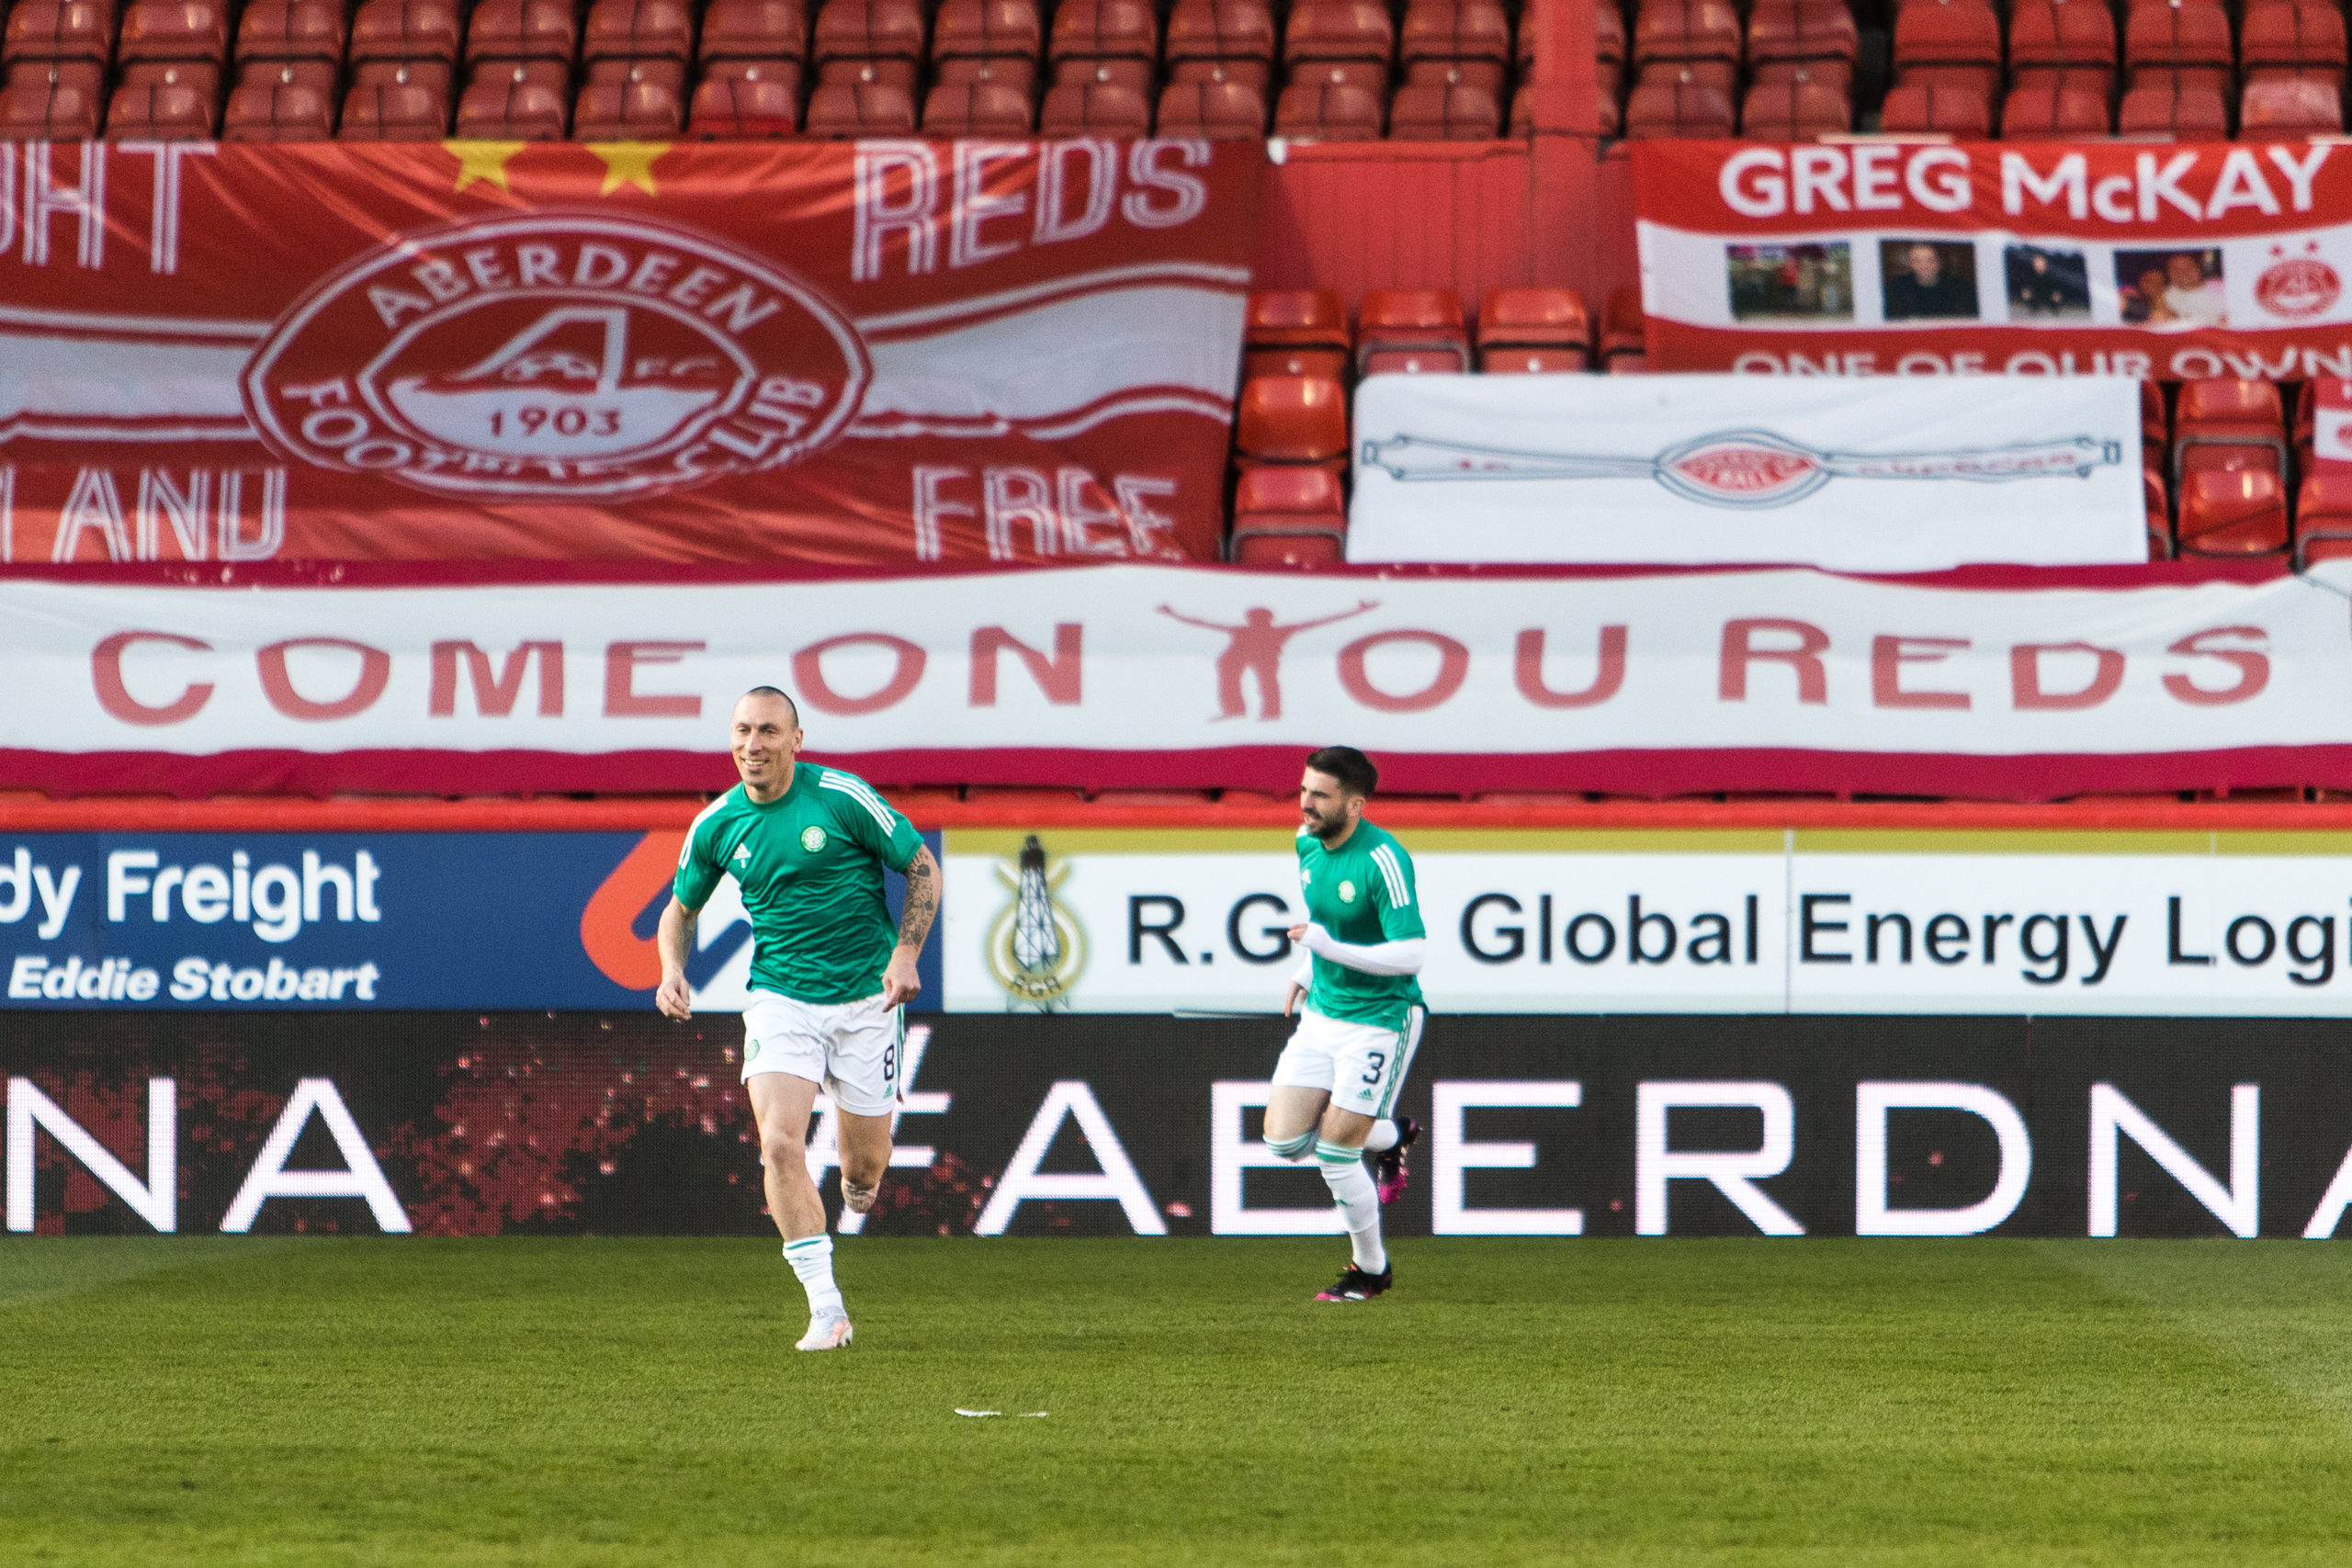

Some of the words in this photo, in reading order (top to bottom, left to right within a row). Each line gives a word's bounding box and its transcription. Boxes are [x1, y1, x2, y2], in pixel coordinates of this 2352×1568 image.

[850, 138, 1212, 281] REDS
[1718, 144, 1973, 219] GREG
[1998, 144, 2336, 222] McKAY
[368, 243, 784, 335] ABERDEEN
[489, 404, 622, 444] 1903
[91, 630, 707, 727] COME
[791, 623, 1084, 716] ON
[1718, 615, 2272, 712] REDS
[107, 849, 382, 943] Freight
[1128, 893, 1292, 965] R.G
[1460, 893, 1758, 965] Global
[1799, 893, 2129, 986] Energy
[7, 954, 161, 1002] Eddie
[168, 955, 380, 1002] Stobart
[884, 1043, 895, 1081] 8
[1363, 1051, 1385, 1085] 3
[5, 1077, 413, 1234] NA
[761, 1023, 2352, 1238] #ABERDN
